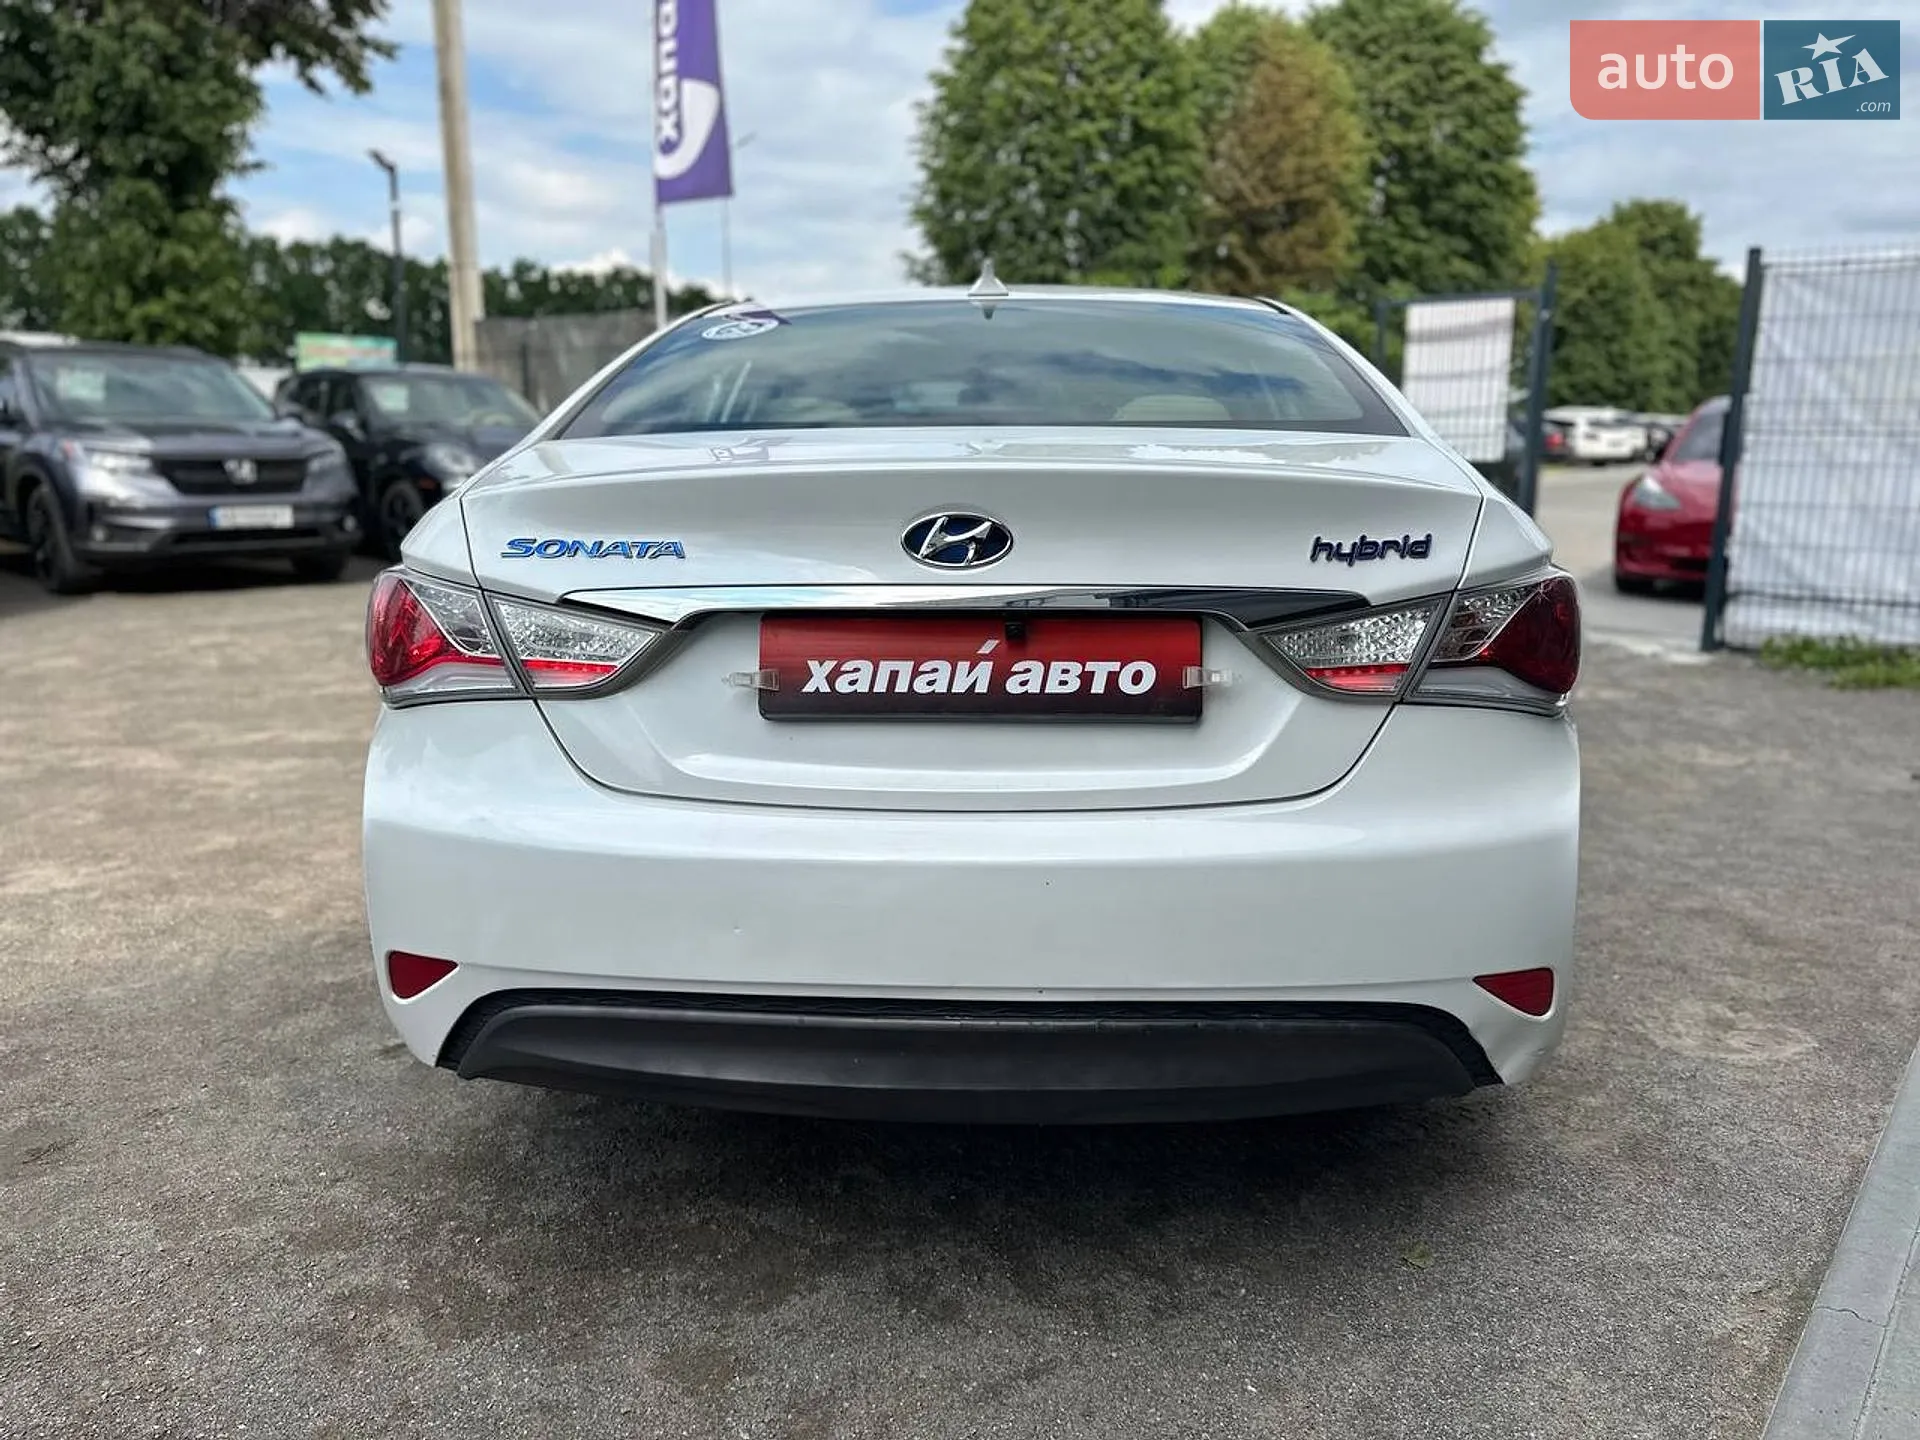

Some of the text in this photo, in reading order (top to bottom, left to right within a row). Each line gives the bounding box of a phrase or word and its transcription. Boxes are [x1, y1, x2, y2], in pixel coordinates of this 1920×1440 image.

[500, 538, 686, 559] SONATA
[1309, 533, 1433, 567] hybrid
[1004, 659, 1157, 695] авто
